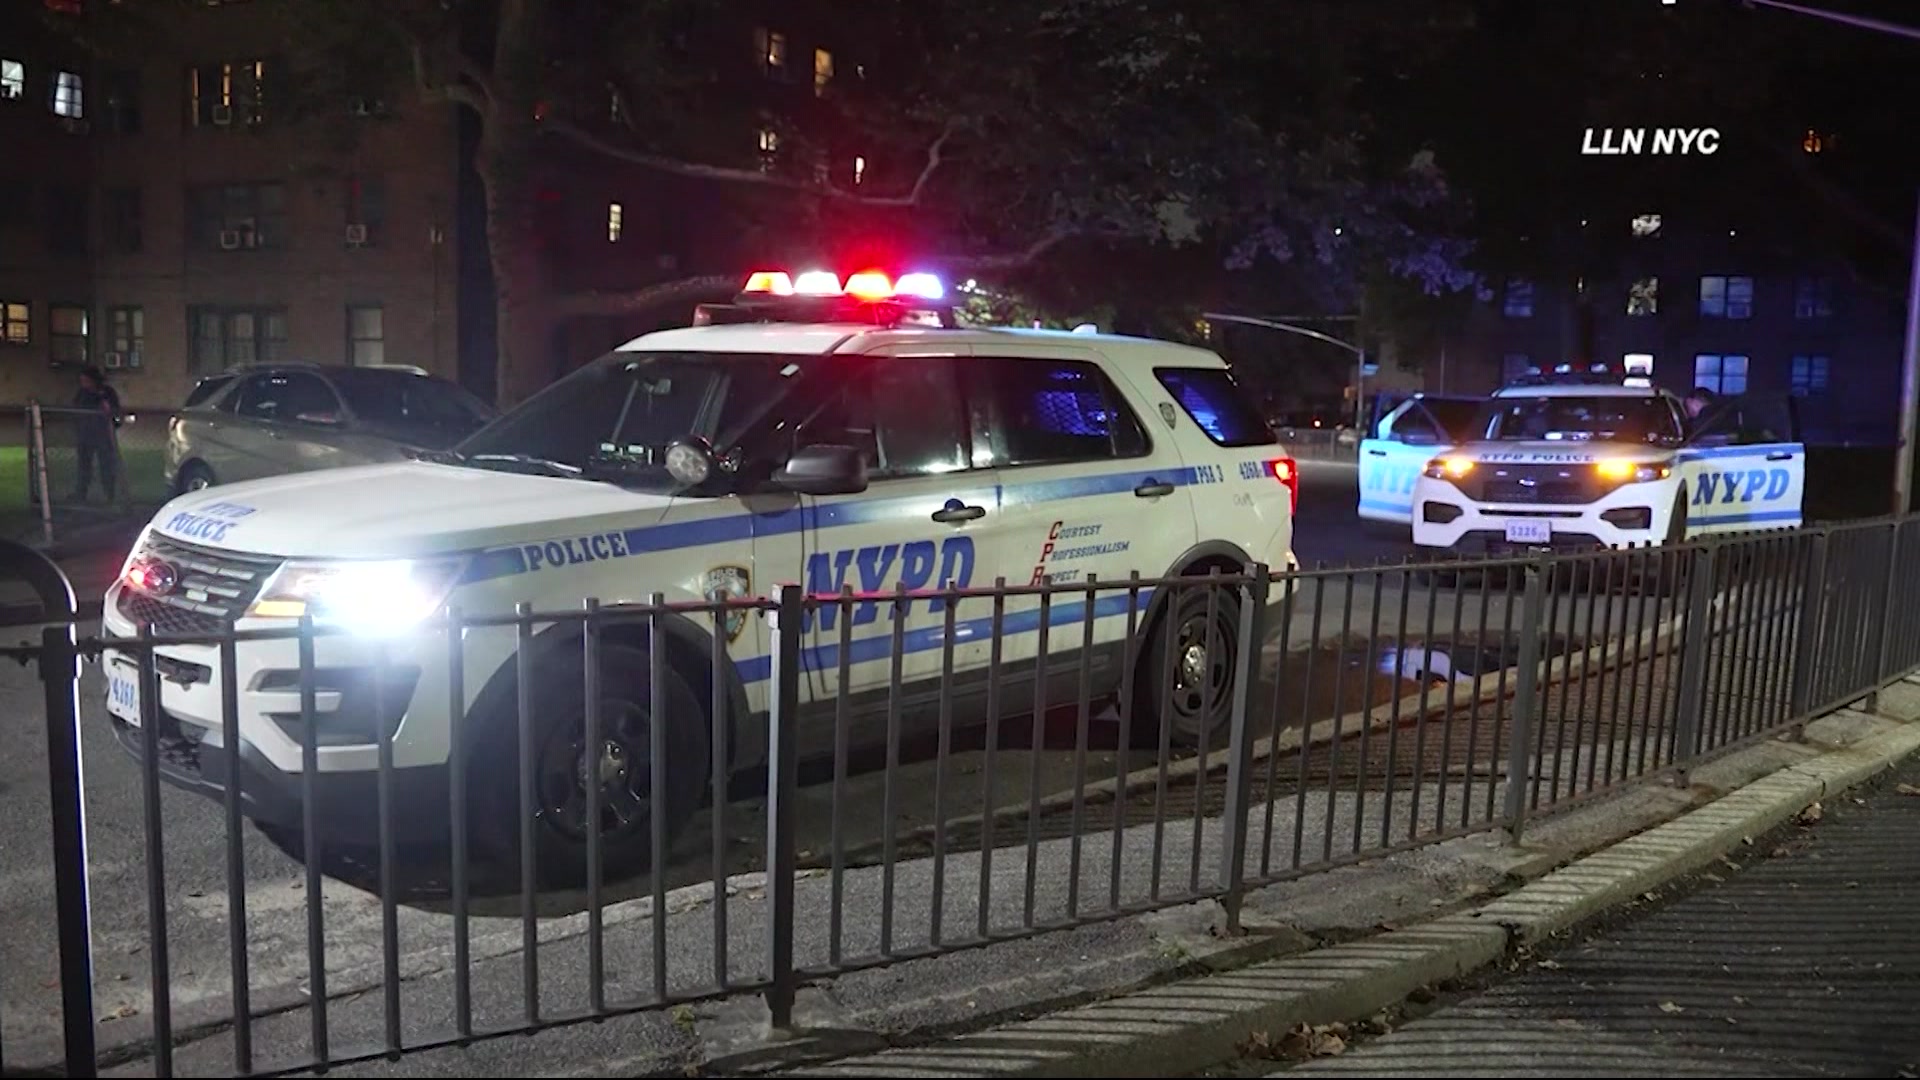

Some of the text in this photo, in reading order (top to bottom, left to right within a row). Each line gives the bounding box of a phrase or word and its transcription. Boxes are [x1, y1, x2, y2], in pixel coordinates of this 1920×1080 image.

[1197, 464, 1224, 484] PSA 3
[1239, 461, 1260, 480] 4268
[1692, 468, 1790, 506] NYPD
[166, 511, 238, 541] POLICE
[1049, 520, 1103, 540] COURTESY
[523, 532, 627, 572] POLICE
[1040, 540, 1130, 563] PROFESSIONALISM
[801, 536, 975, 634] NYPD
[1030, 565, 1080, 587] RSPECT
